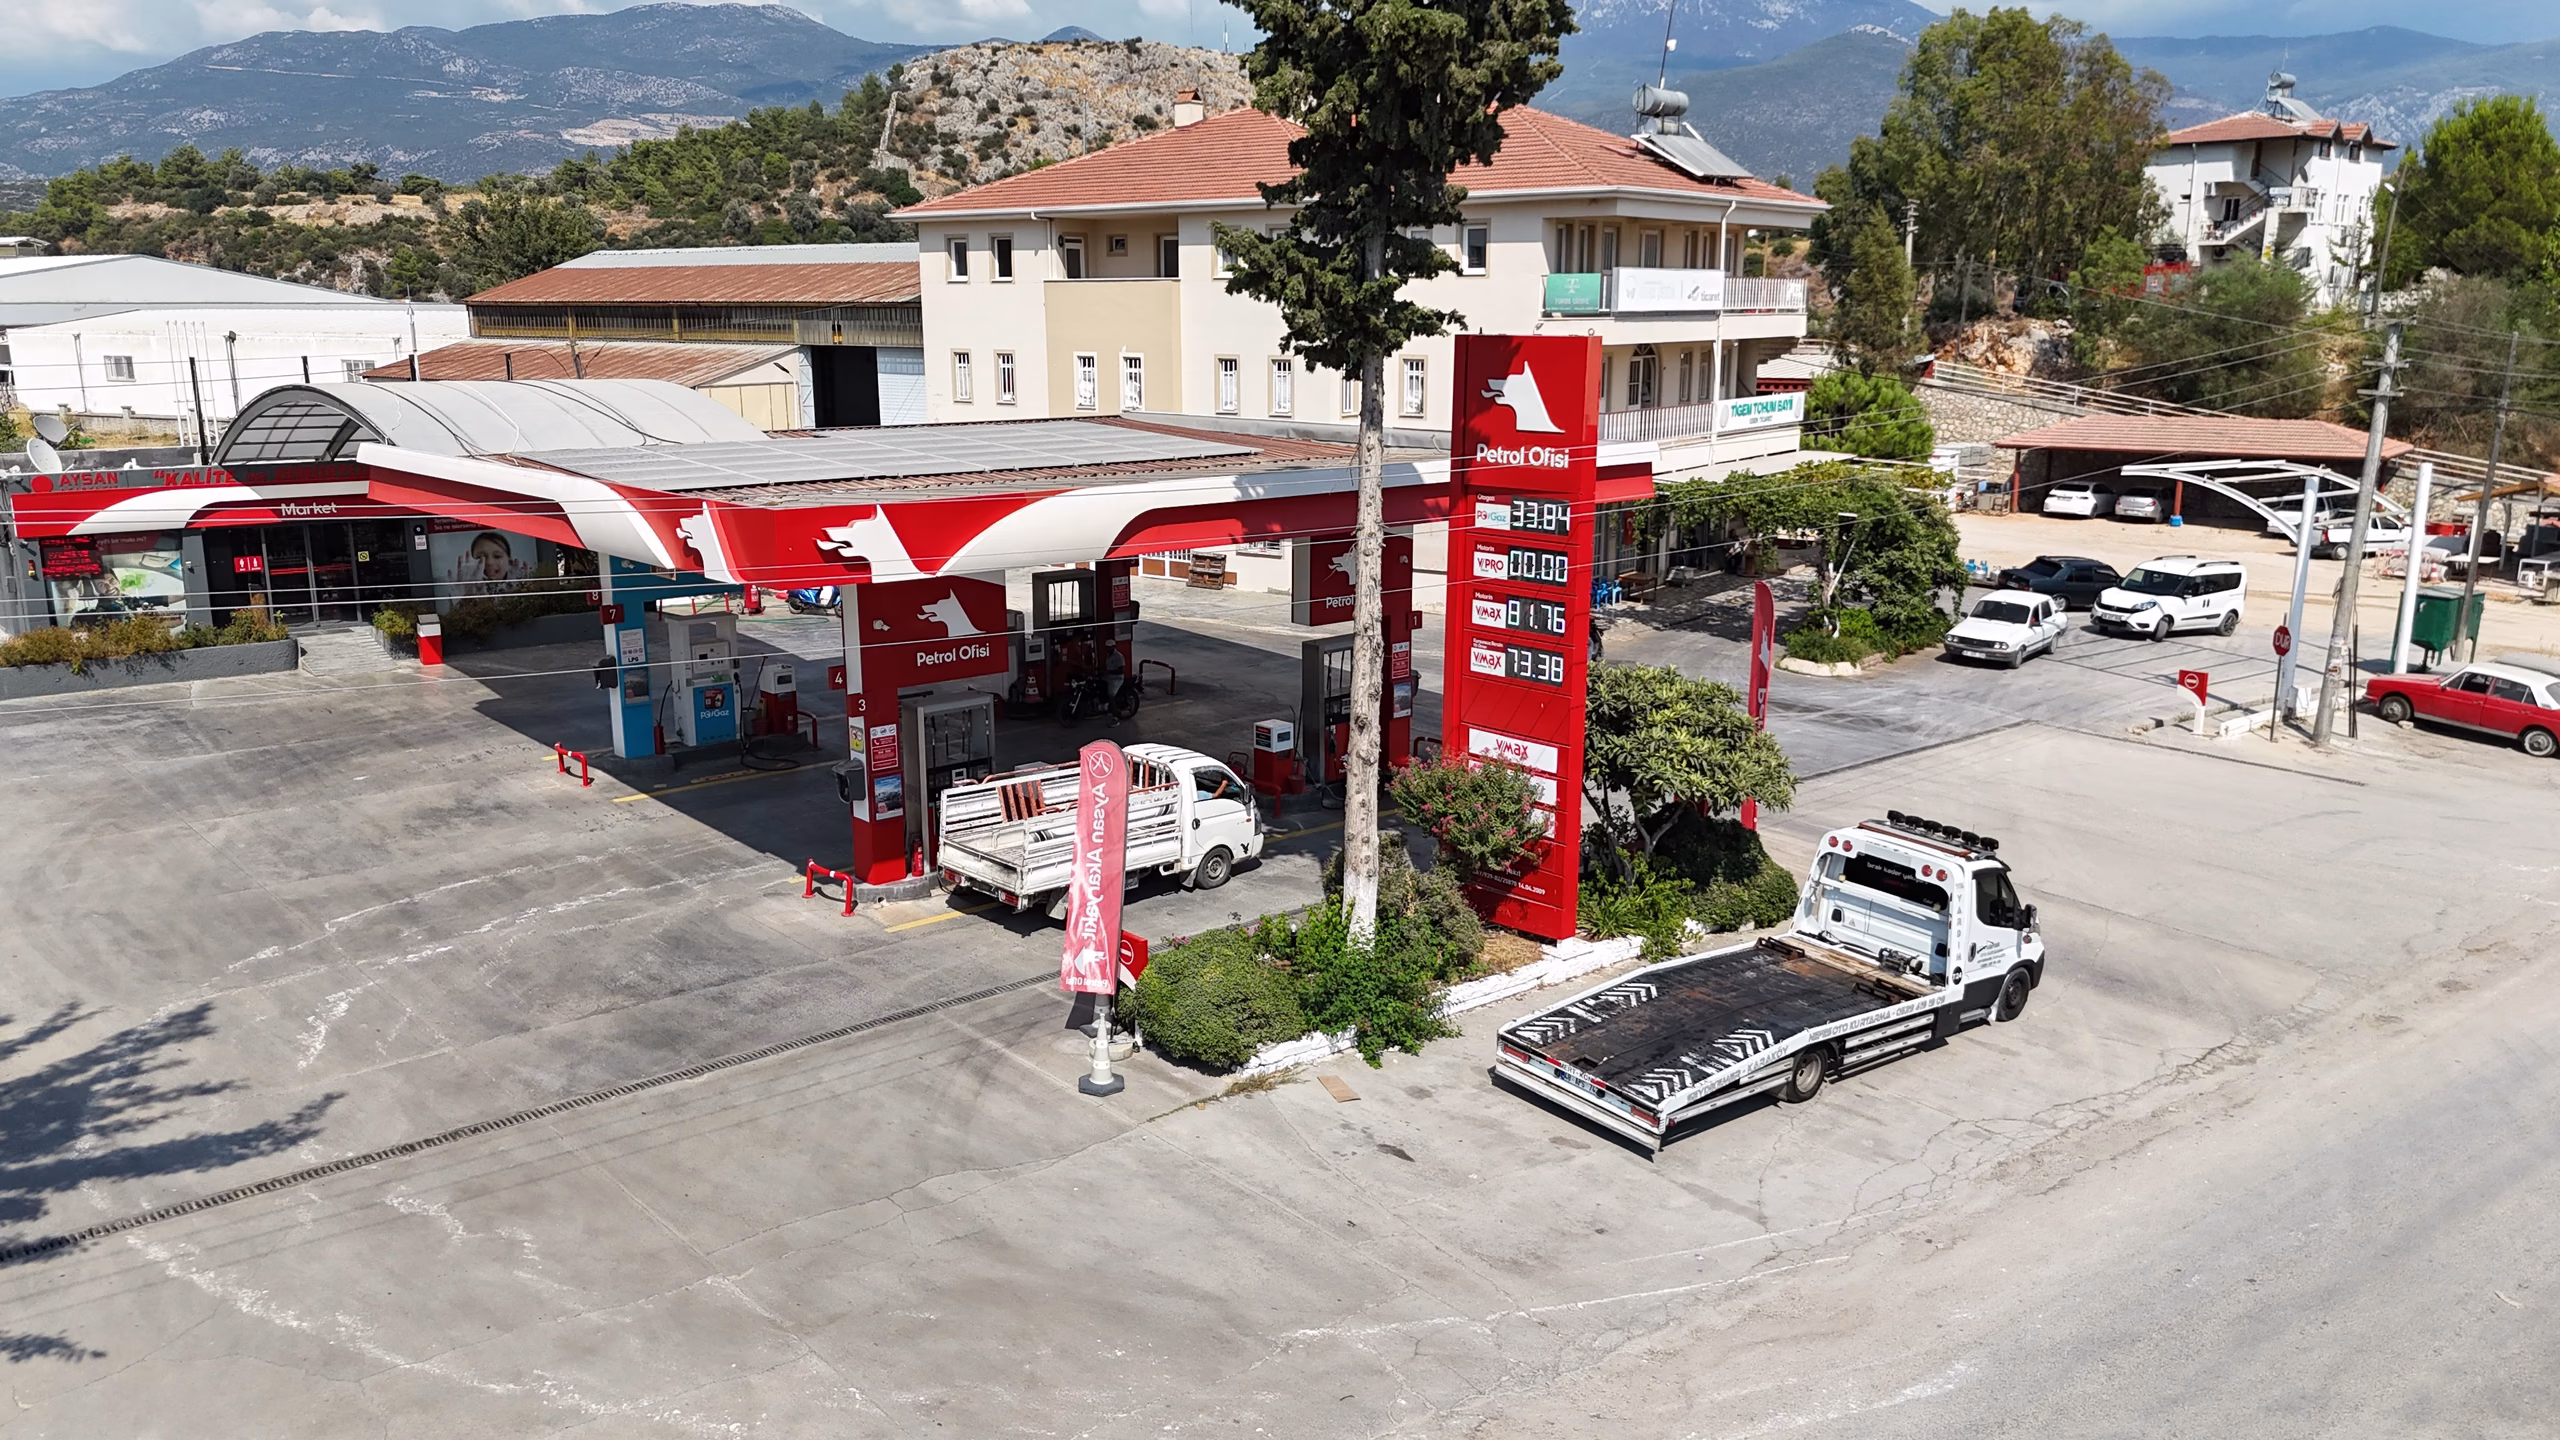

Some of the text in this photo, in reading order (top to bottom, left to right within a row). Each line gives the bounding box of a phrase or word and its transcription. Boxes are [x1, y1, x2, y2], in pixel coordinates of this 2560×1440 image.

[1476, 443, 1569, 468] Petrol Ofisi
[59, 472, 118, 487] AYSAN
[281, 501, 338, 517] Market
[1512, 500, 1571, 532] 33.84
[1476, 544, 1495, 552] Motorin
[1510, 550, 1568, 582] 00.00
[592, 589, 599, 601] 8
[1326, 595, 1355, 609] Petrol
[1475, 592, 1494, 600] Motorin
[609, 608, 616, 620] 7
[1413, 615, 1418, 626] 1
[1508, 599, 1566, 634] 81.76
[2275, 631, 2291, 650] DUR
[916, 643, 990, 667] Petrol Ofisi
[1507, 647, 1564, 683] 73.38
[835, 671, 843, 684] 4
[858, 698, 866, 711] 3
[1832, 1021, 1849, 1037] OTO
[1849, 1010, 1891, 1031] KURTARMA
[1747, 1045, 1789, 1073] KARAKÖY
